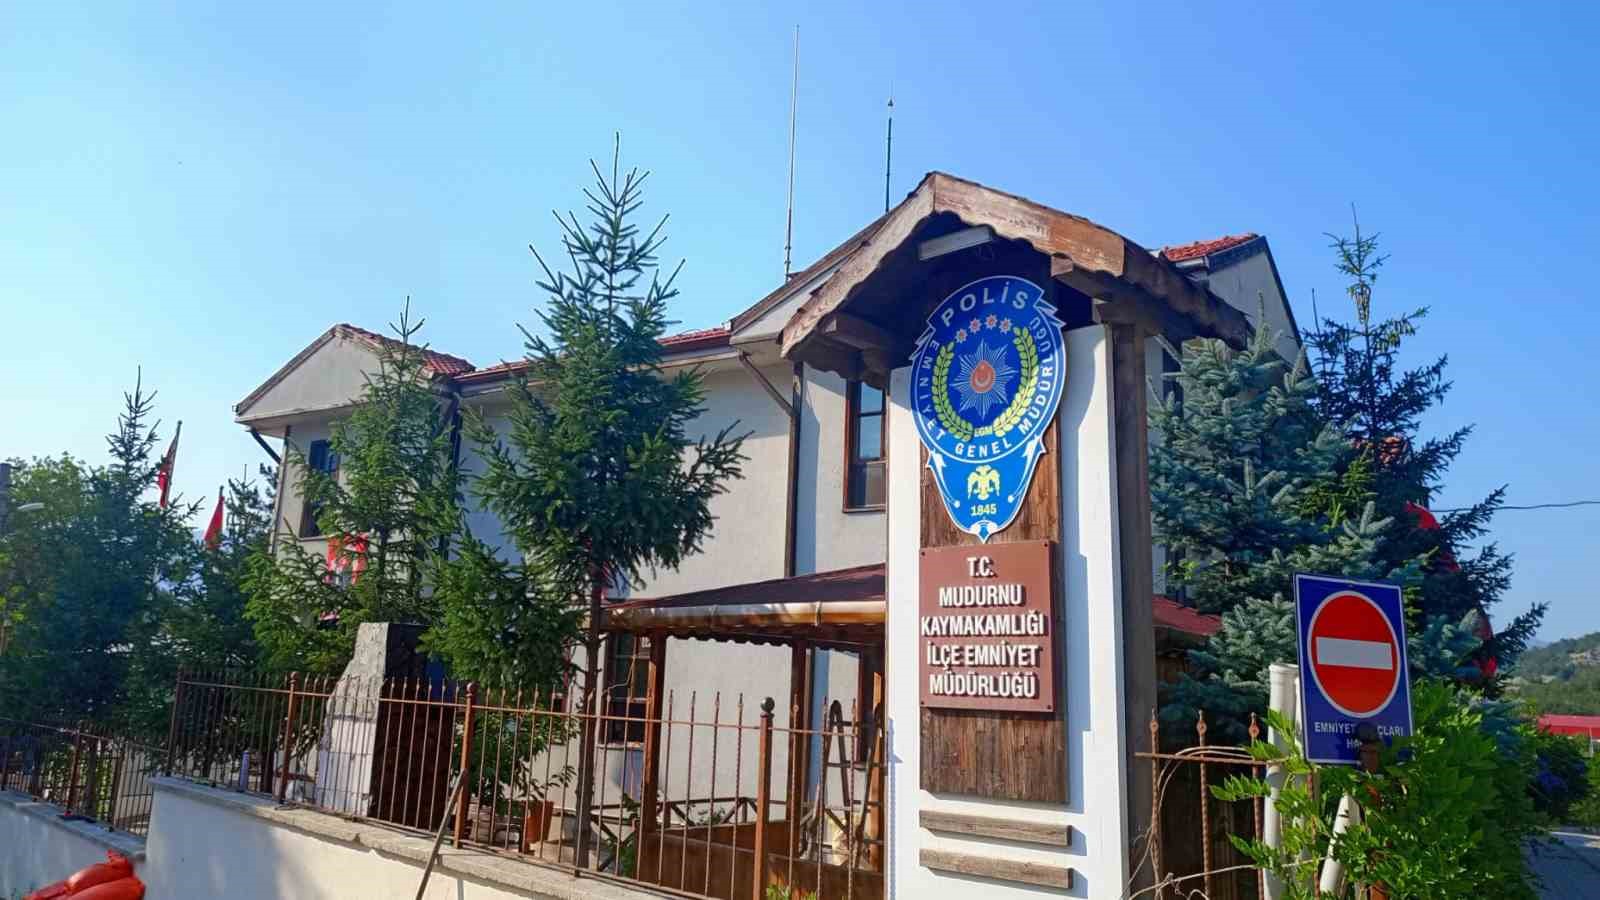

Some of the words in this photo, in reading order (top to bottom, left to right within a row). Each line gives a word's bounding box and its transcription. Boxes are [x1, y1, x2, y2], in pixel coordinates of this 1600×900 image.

[941, 282, 1028, 327] POLİS
[955, 439, 1012, 458] GENEL
[970, 503, 997, 516] 1845
[967, 556, 994, 576] T.C.
[939, 585, 1022, 606] MUDURNU
[921, 610, 1045, 635] KAYMAKAMLIĞI
[927, 641, 960, 670] İLÇE
[965, 641, 1038, 666] EMNİYET
[929, 671, 1036, 697] MÜDÜRLÜĞÜ
[1314, 722, 1355, 734] EMNİYET
